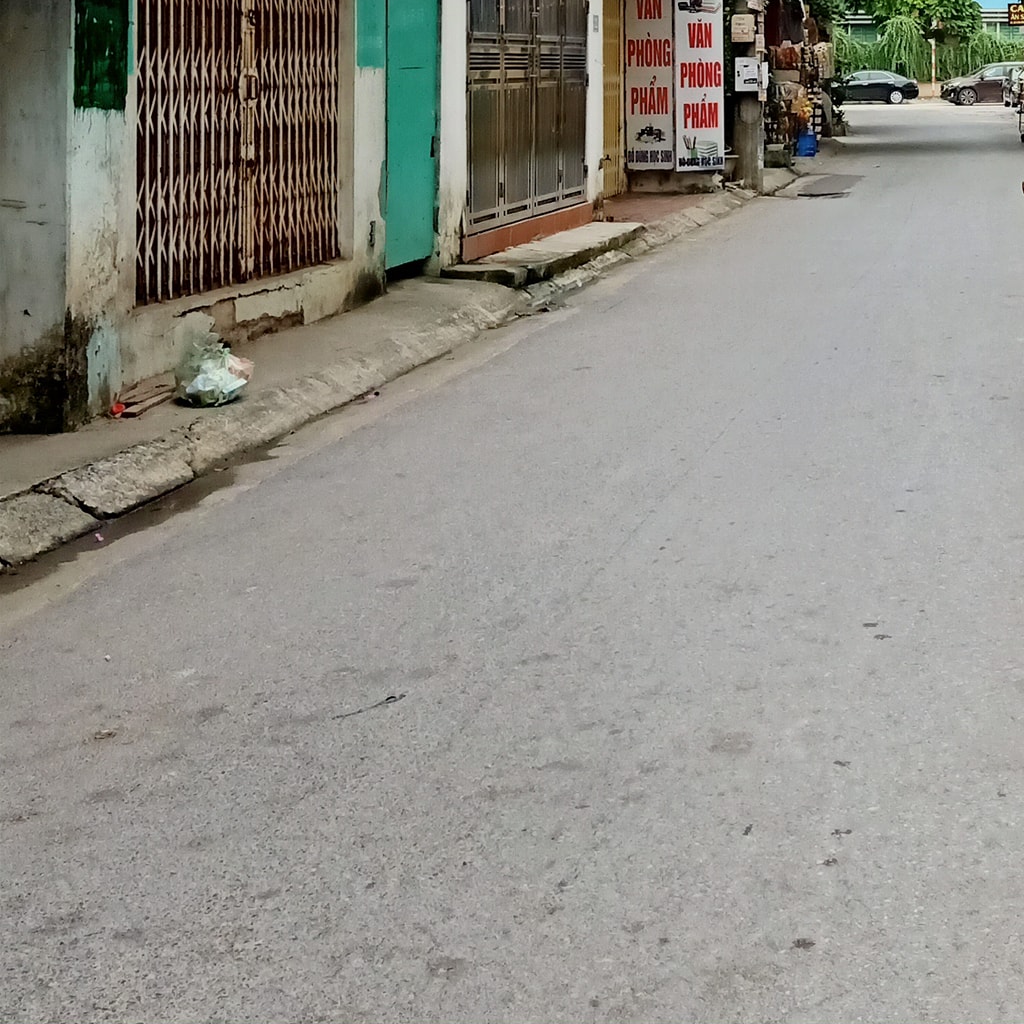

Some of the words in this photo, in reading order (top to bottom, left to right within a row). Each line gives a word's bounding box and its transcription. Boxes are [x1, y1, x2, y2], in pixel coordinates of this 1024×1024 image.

[627, 33, 671, 68] PHÒNG
[687, 19, 712, 49] VĂN
[680, 58, 721, 88] PHÒNG
[630, 77, 669, 115] PHẨM
[683, 93, 719, 129] PHẨM
